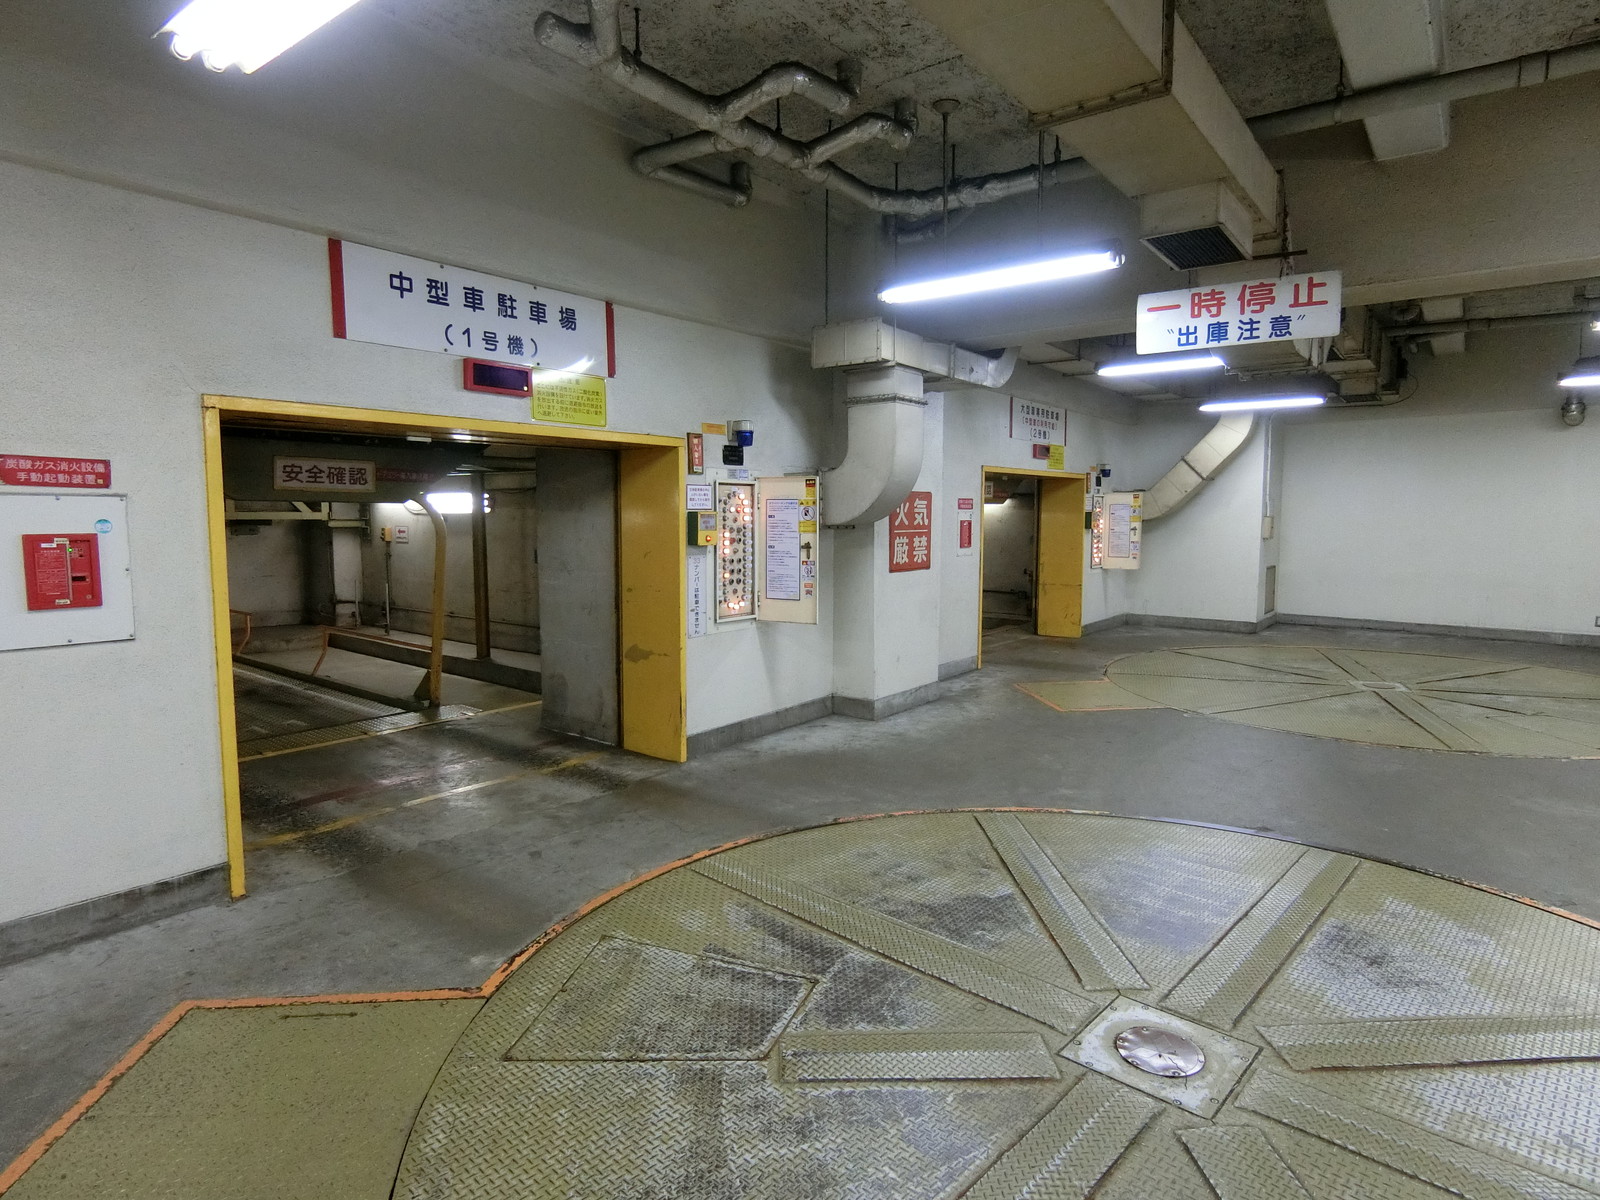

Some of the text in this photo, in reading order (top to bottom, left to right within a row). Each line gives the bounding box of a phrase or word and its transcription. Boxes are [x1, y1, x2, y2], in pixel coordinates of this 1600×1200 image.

[388, 270, 579, 332] 中型車駐車場
[1146, 276, 1329, 319] 一時停止
[5, 458, 106, 473] 炭酸ガス消火設備
[16, 471, 97, 485] 手動起動装置
[281, 463, 370, 486] 安全確認
[894, 497, 929, 526] 火気
[892, 535, 928, 565] 厳禁
